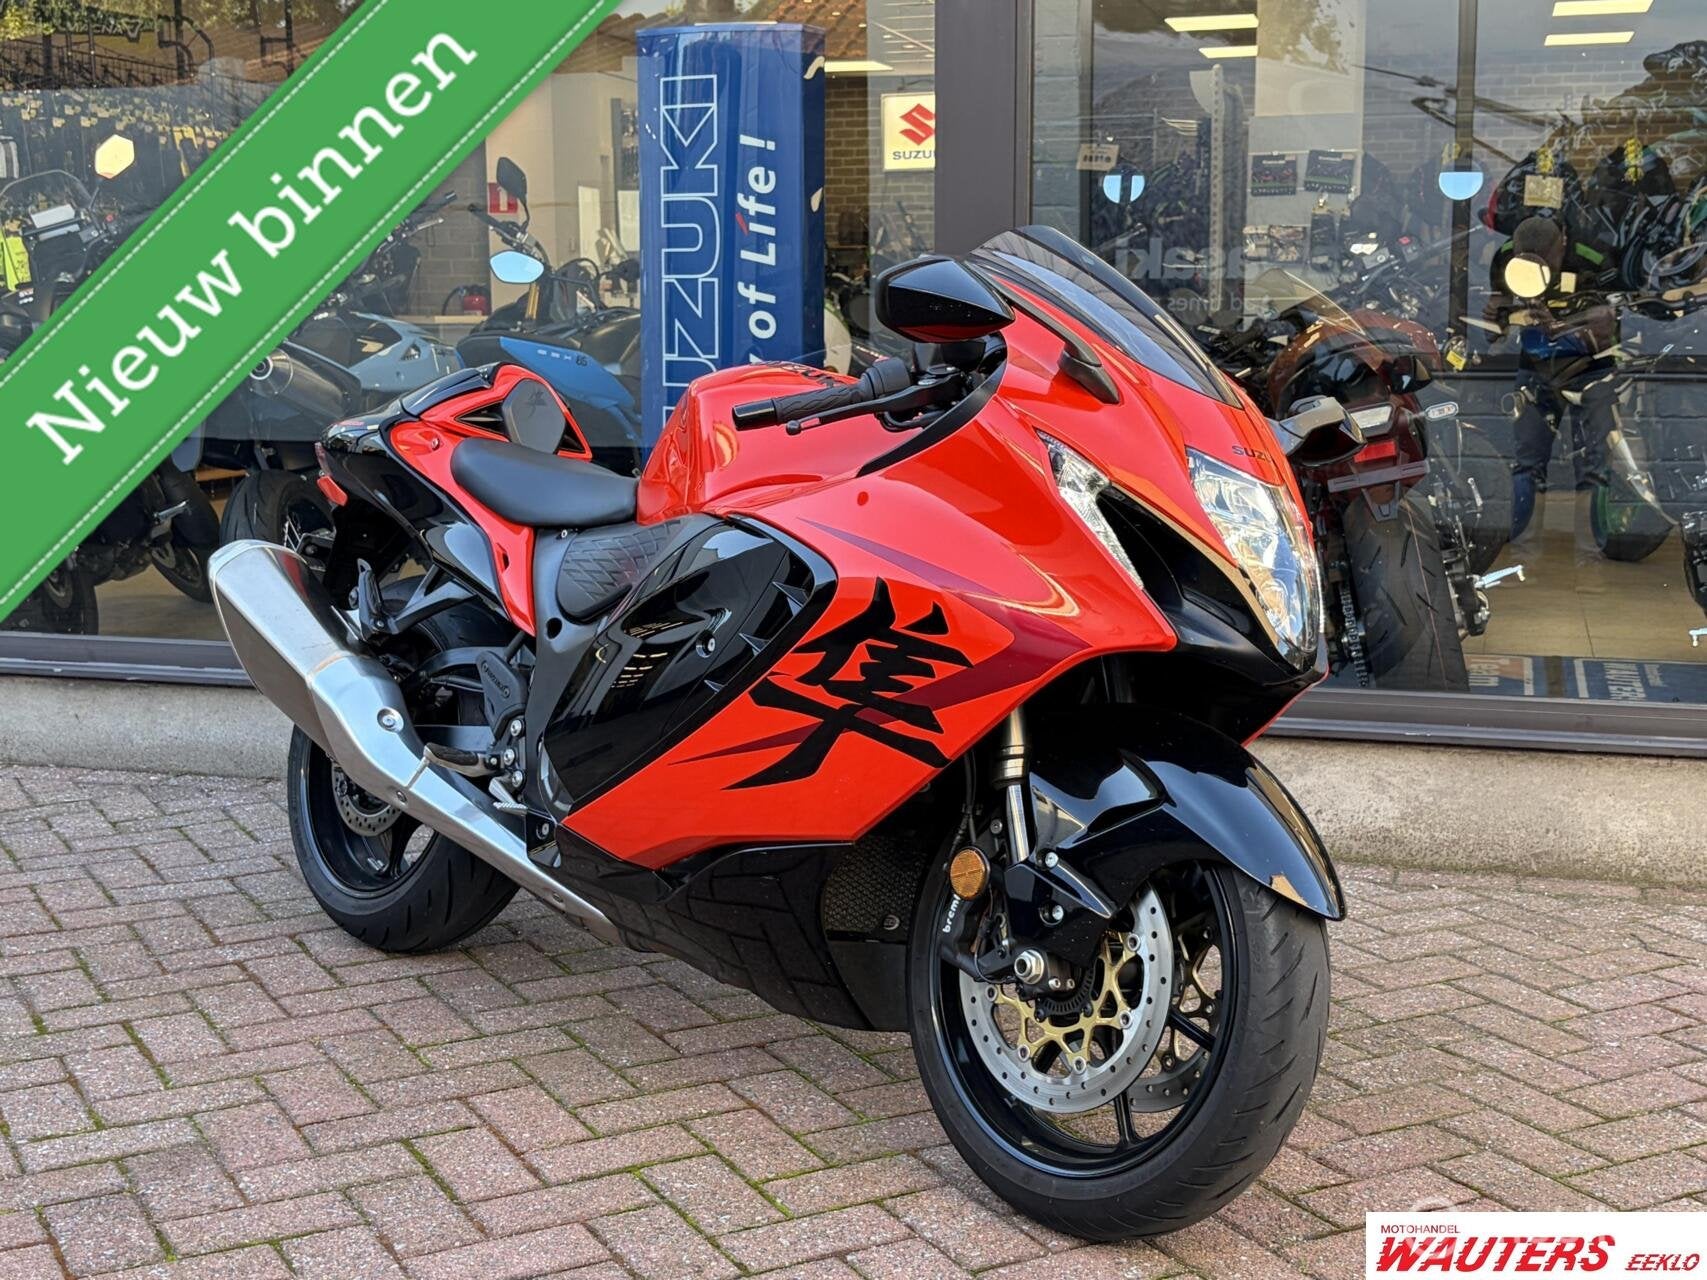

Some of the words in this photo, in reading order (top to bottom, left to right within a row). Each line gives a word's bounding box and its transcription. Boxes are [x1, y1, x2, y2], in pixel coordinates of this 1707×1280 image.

[892, 150, 935, 160] SUZU
[736, 134, 777, 267] Life!
[738, 280, 777, 341] of
[1231, 445, 1269, 463] SUZ
[720, 577, 975, 791] 隼
[942, 893, 961, 933] brem
